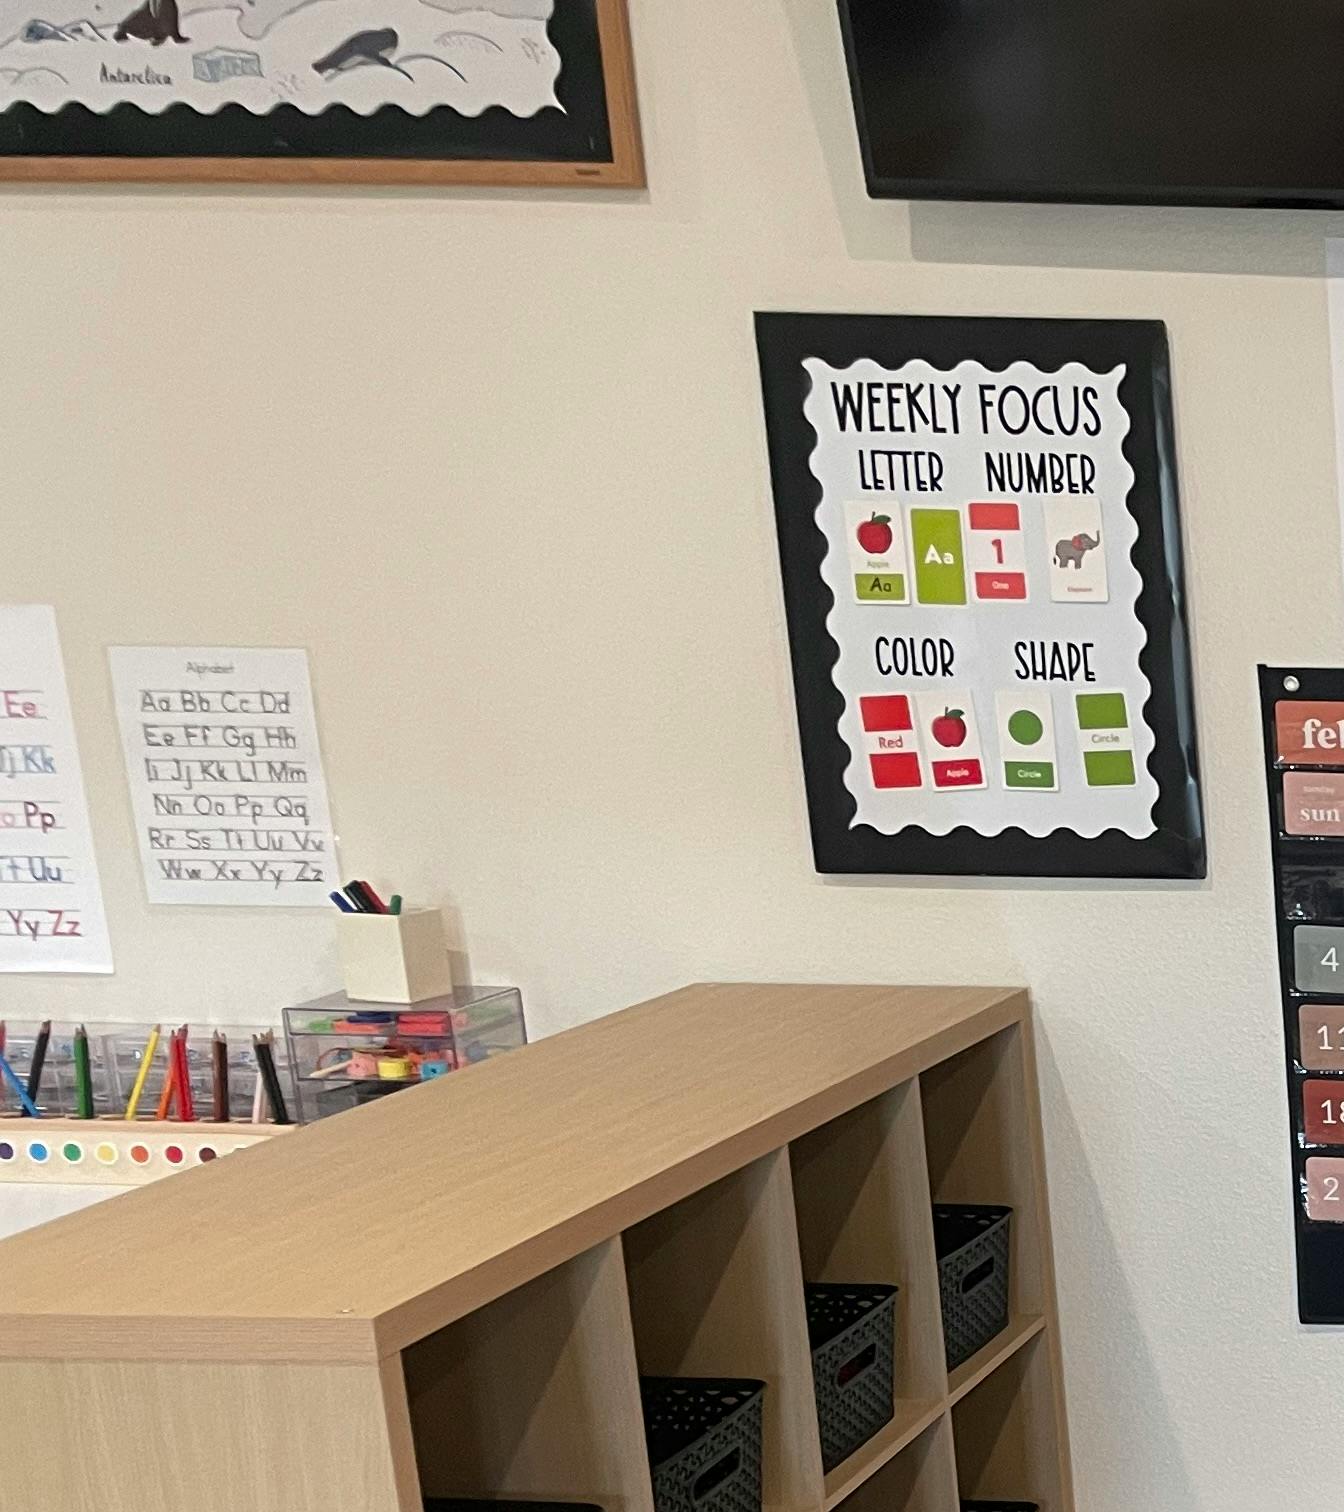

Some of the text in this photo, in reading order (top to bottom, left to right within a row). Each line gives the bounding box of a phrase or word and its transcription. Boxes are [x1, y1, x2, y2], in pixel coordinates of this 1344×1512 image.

[830, 381, 1102, 437] WEEKLY FOCUS
[858, 449, 944, 492] LETTER
[985, 452, 1096, 494] NUMBER
[924, 544, 954, 565] Aa
[991, 538, 1004, 564] 1
[869, 577, 892, 593] Aa
[875, 636, 955, 677] COLOR
[1014, 641, 1096, 682] SHAPE
[878, 736, 903, 749] Red
[1091, 733, 1120, 744] Circle
[1300, 806, 1340, 822] sun
[1320, 947, 1340, 972] 4
